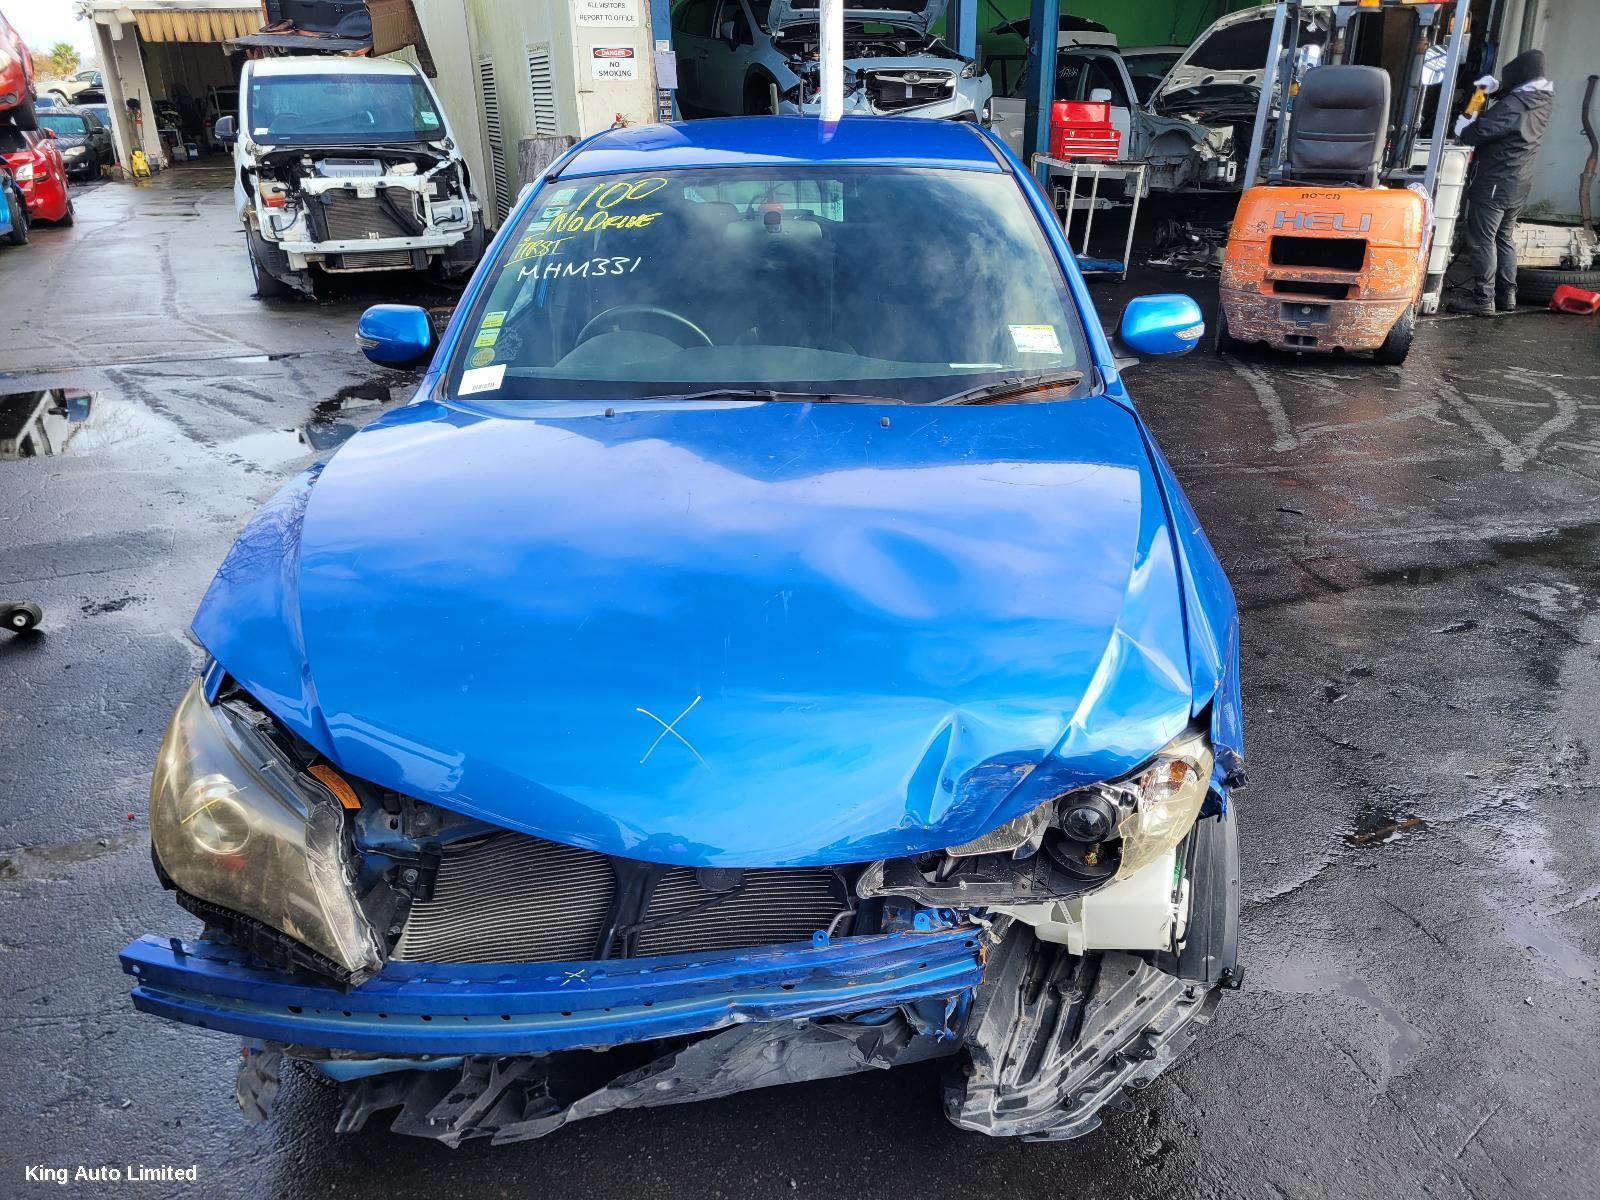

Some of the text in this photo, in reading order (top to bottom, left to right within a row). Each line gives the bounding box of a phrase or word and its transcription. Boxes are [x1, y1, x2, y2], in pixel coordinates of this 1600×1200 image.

[587, 1, 598, 9] ALL
[601, 49, 626, 57] DANGER
[1273, 210, 1372, 232] HELI
[516, 256, 642, 282] MHM331
